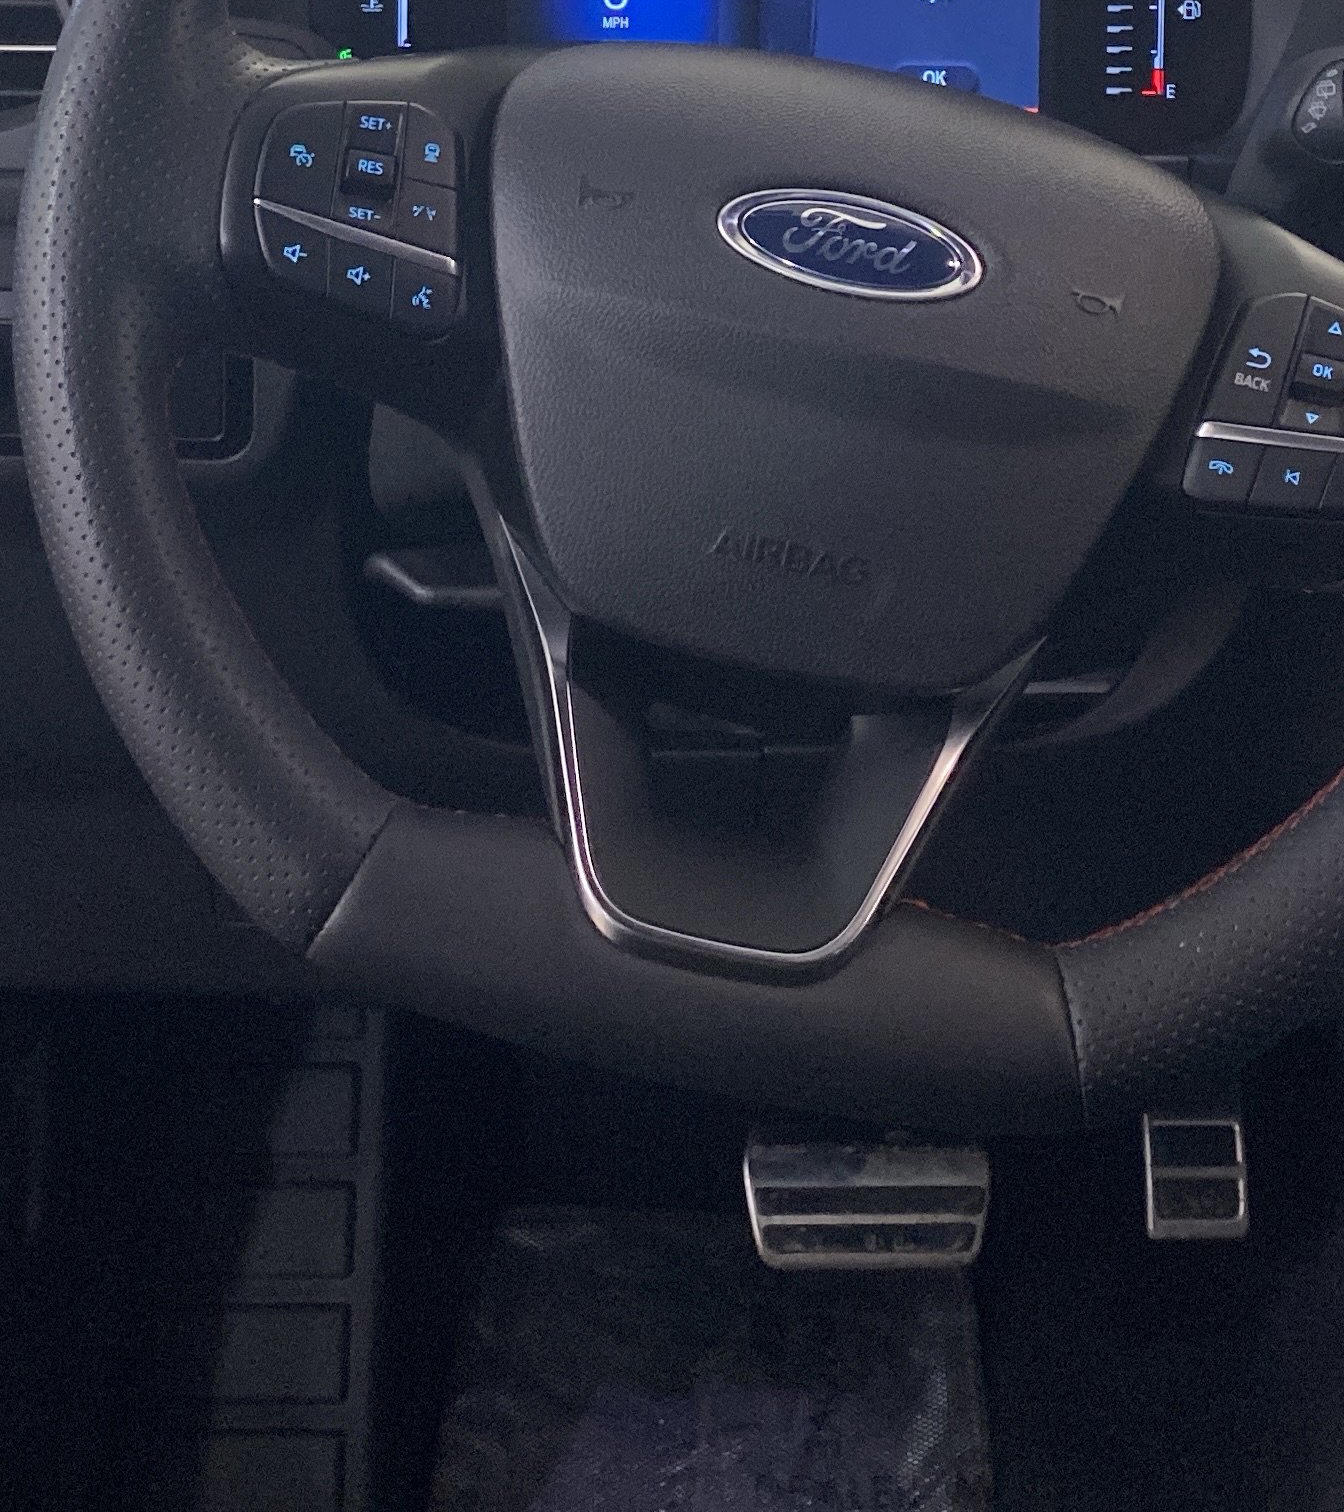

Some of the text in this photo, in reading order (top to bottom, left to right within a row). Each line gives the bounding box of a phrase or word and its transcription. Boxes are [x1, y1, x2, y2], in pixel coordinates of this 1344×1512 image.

[601, 16, 630, 29] MPH
[922, 70, 948, 87] OK
[1165, 83, 1177, 99] E
[359, 115, 393, 131] SET+
[357, 159, 384, 176] RES
[782, 206, 918, 274] Ford
[1311, 363, 1334, 380] OK
[1233, 372, 1272, 393] BACK
[706, 525, 872, 586] AIRBAG
